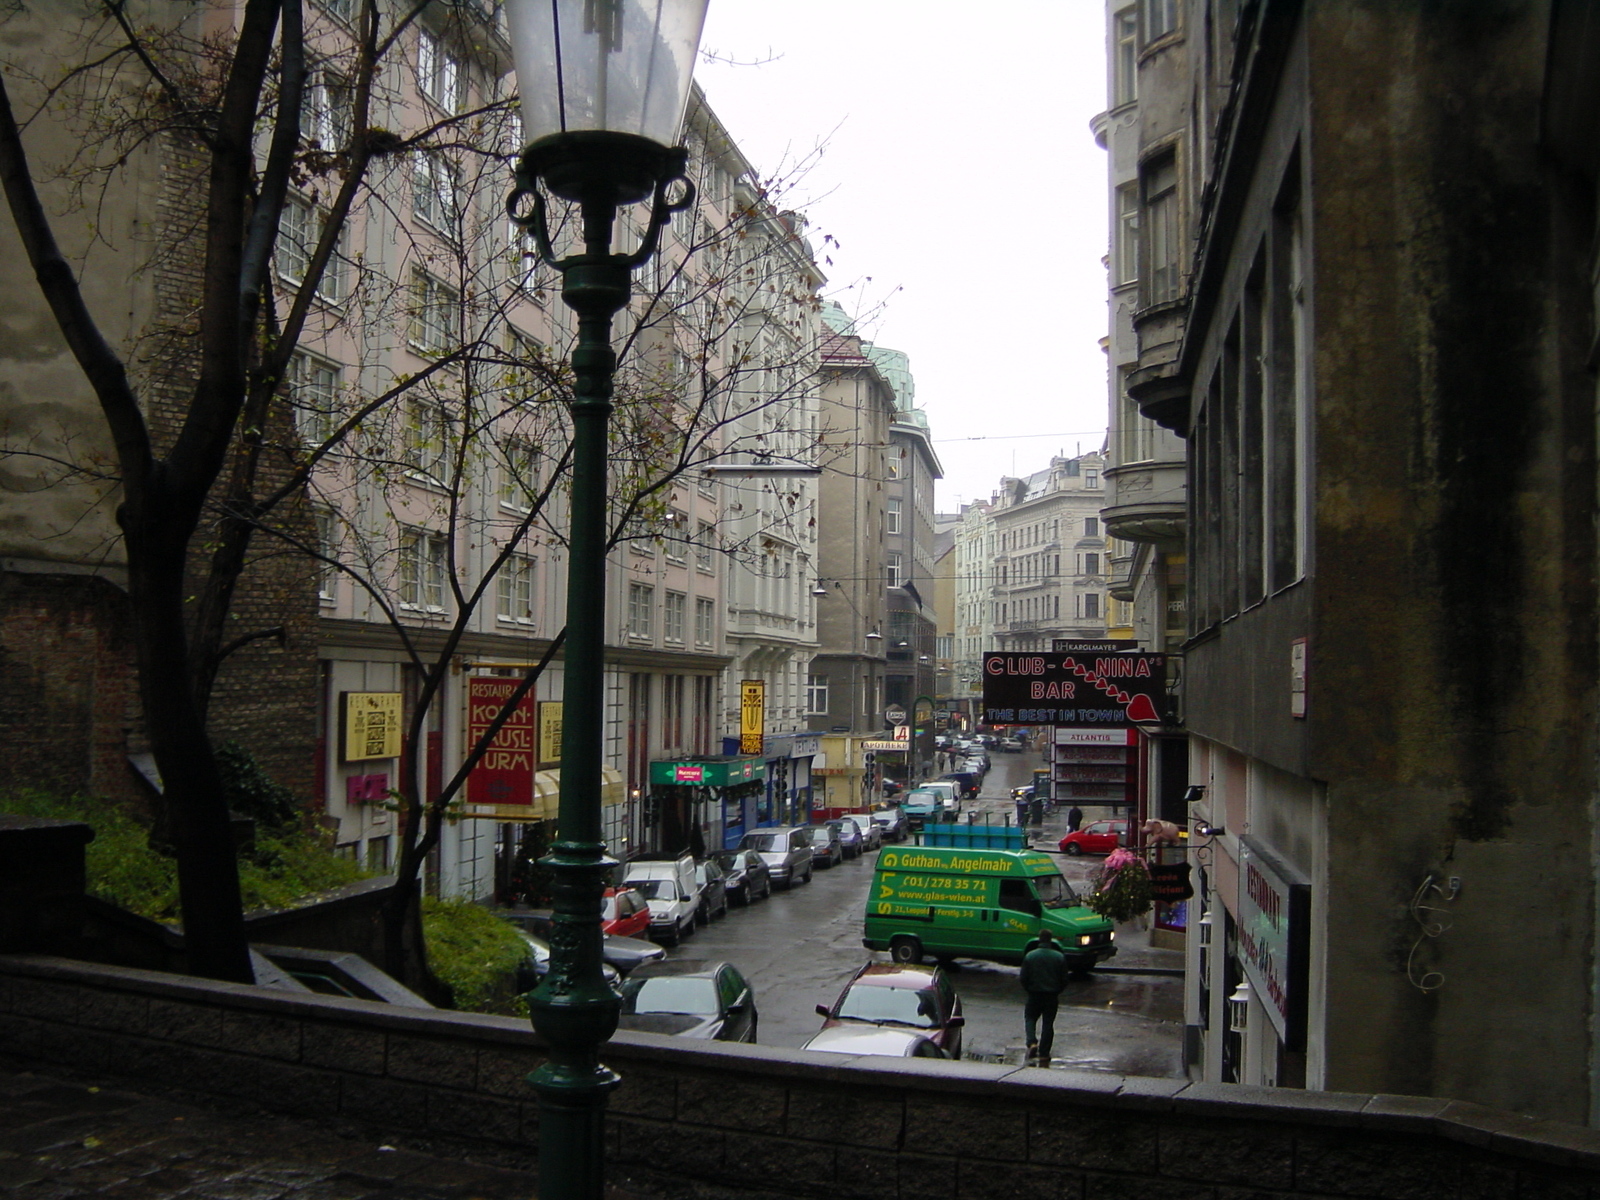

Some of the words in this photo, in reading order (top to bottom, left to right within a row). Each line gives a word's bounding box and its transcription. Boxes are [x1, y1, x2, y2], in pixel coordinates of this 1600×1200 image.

[1068, 643, 1117, 651] KARGLMAYER
[1096, 657, 1163, 677] NINA'S
[1031, 681, 1075, 699] BAR
[987, 708, 1014, 721] THE
[1018, 708, 1056, 721] BEST
[1059, 708, 1075, 721] IN
[1079, 708, 1125, 721] TOWN
[475, 752, 530, 770] URM
[901, 853, 941, 868] Guthan
[950, 856, 1012, 873] Angelmahr
[878, 853, 897, 915] GLAS
[955, 879, 969, 889] 35
[973, 880, 986, 890] 71
[898, 890, 986, 903] www.glas-wien.at
